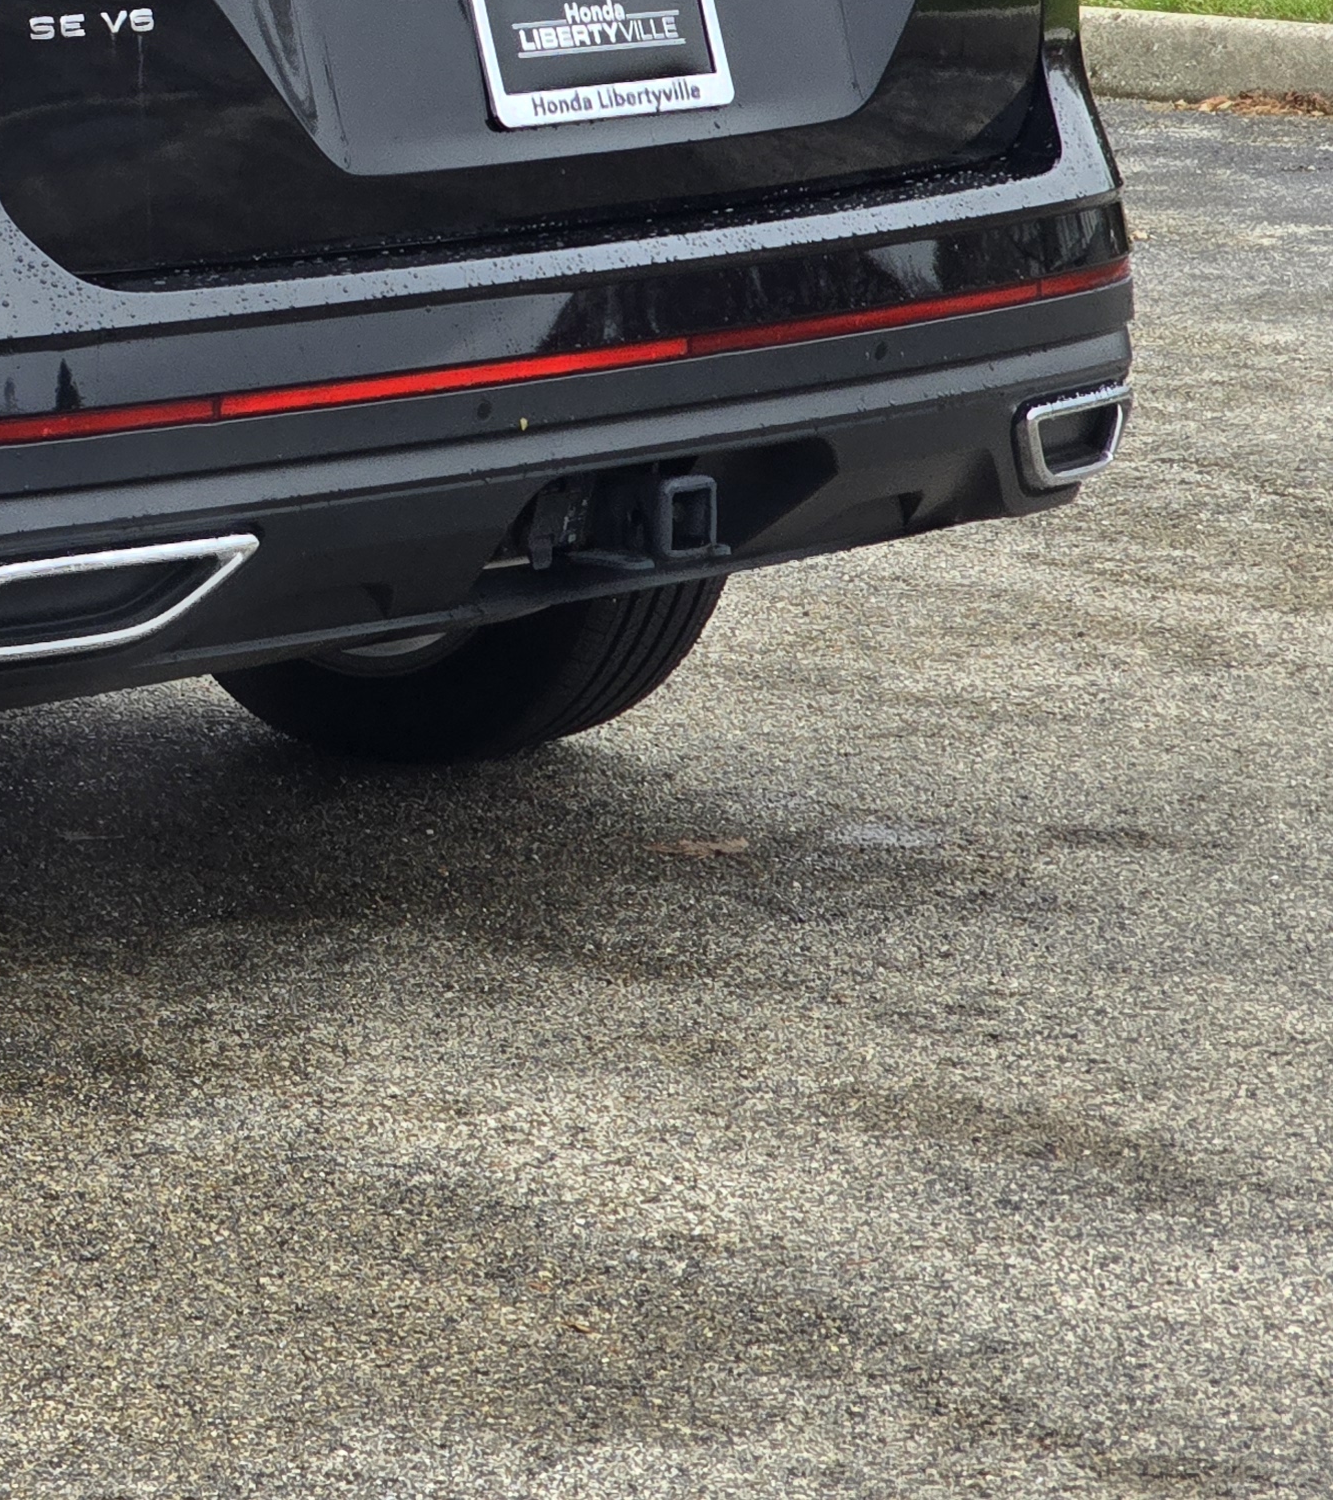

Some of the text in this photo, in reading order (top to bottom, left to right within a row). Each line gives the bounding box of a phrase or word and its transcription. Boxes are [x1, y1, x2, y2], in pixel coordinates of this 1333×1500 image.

[29, 7, 155, 40] SE V6
[518, 16, 679, 51] LIBERTYVILLE
[532, 78, 701, 117] Honda Libertyville
